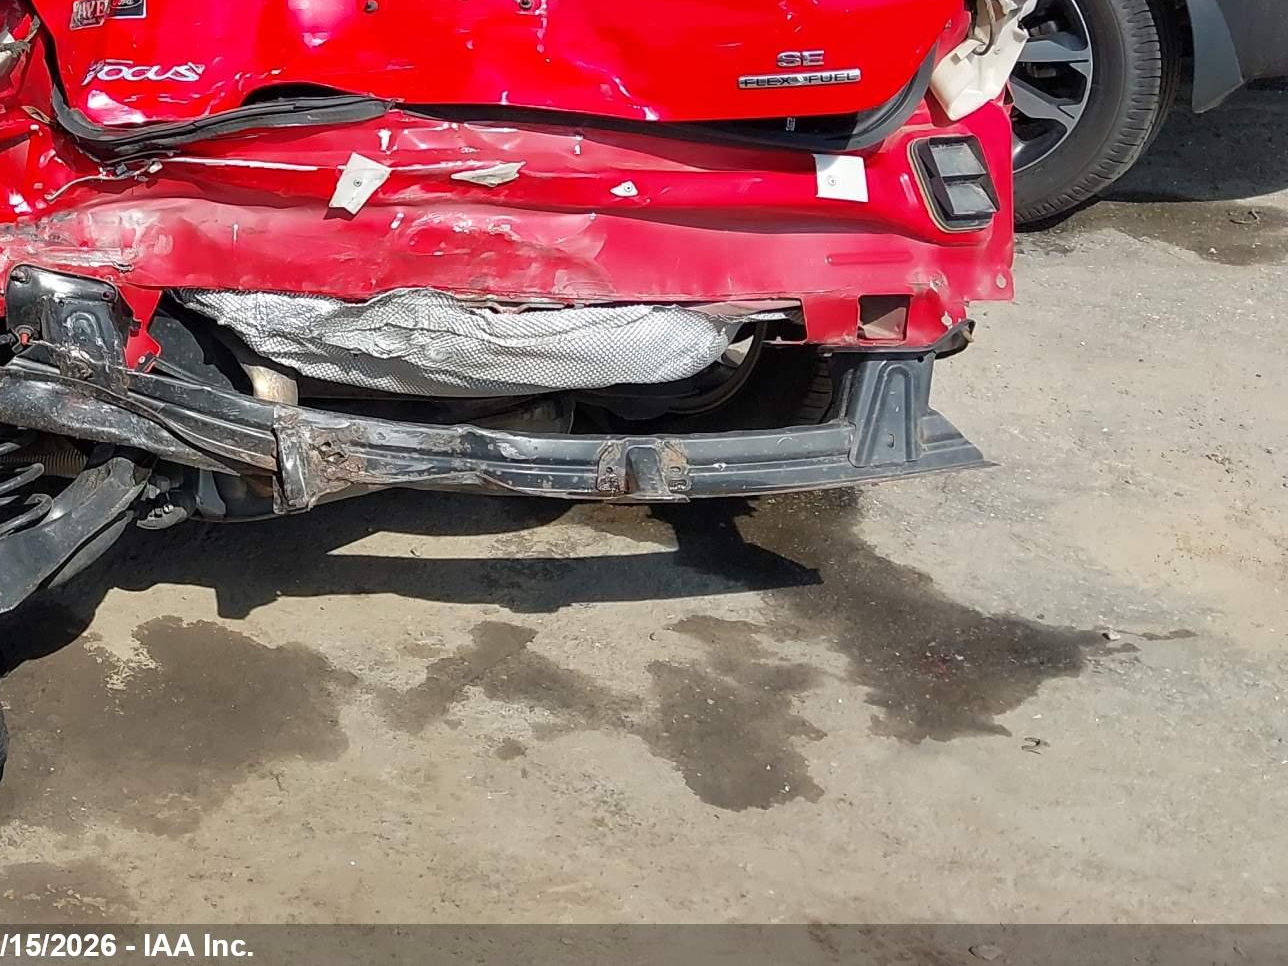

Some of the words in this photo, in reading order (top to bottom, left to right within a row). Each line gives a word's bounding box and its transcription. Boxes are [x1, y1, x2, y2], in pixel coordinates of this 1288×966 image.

[776, 50, 825, 68] SE
[743, 77, 792, 88] FLEX
[808, 72, 859, 84] FUEL
